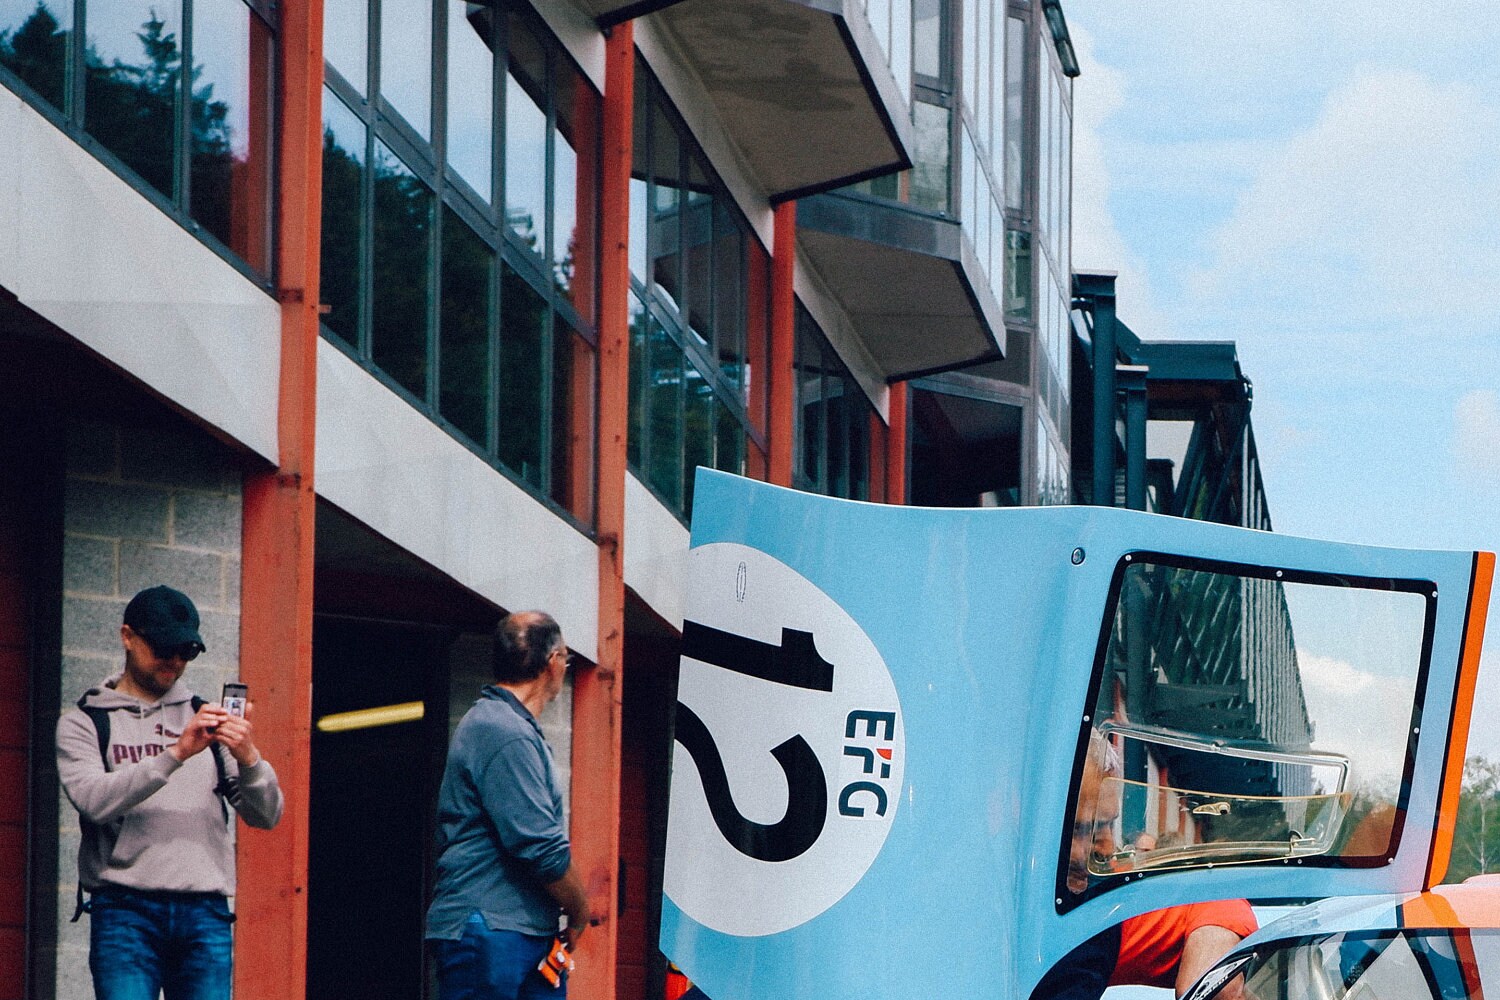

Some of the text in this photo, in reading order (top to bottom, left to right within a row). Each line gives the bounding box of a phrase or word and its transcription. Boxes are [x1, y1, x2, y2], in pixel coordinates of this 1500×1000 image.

[112, 743, 168, 765] PUM
[673, 618, 835, 863] 12
[838, 709, 896, 818] EFG
